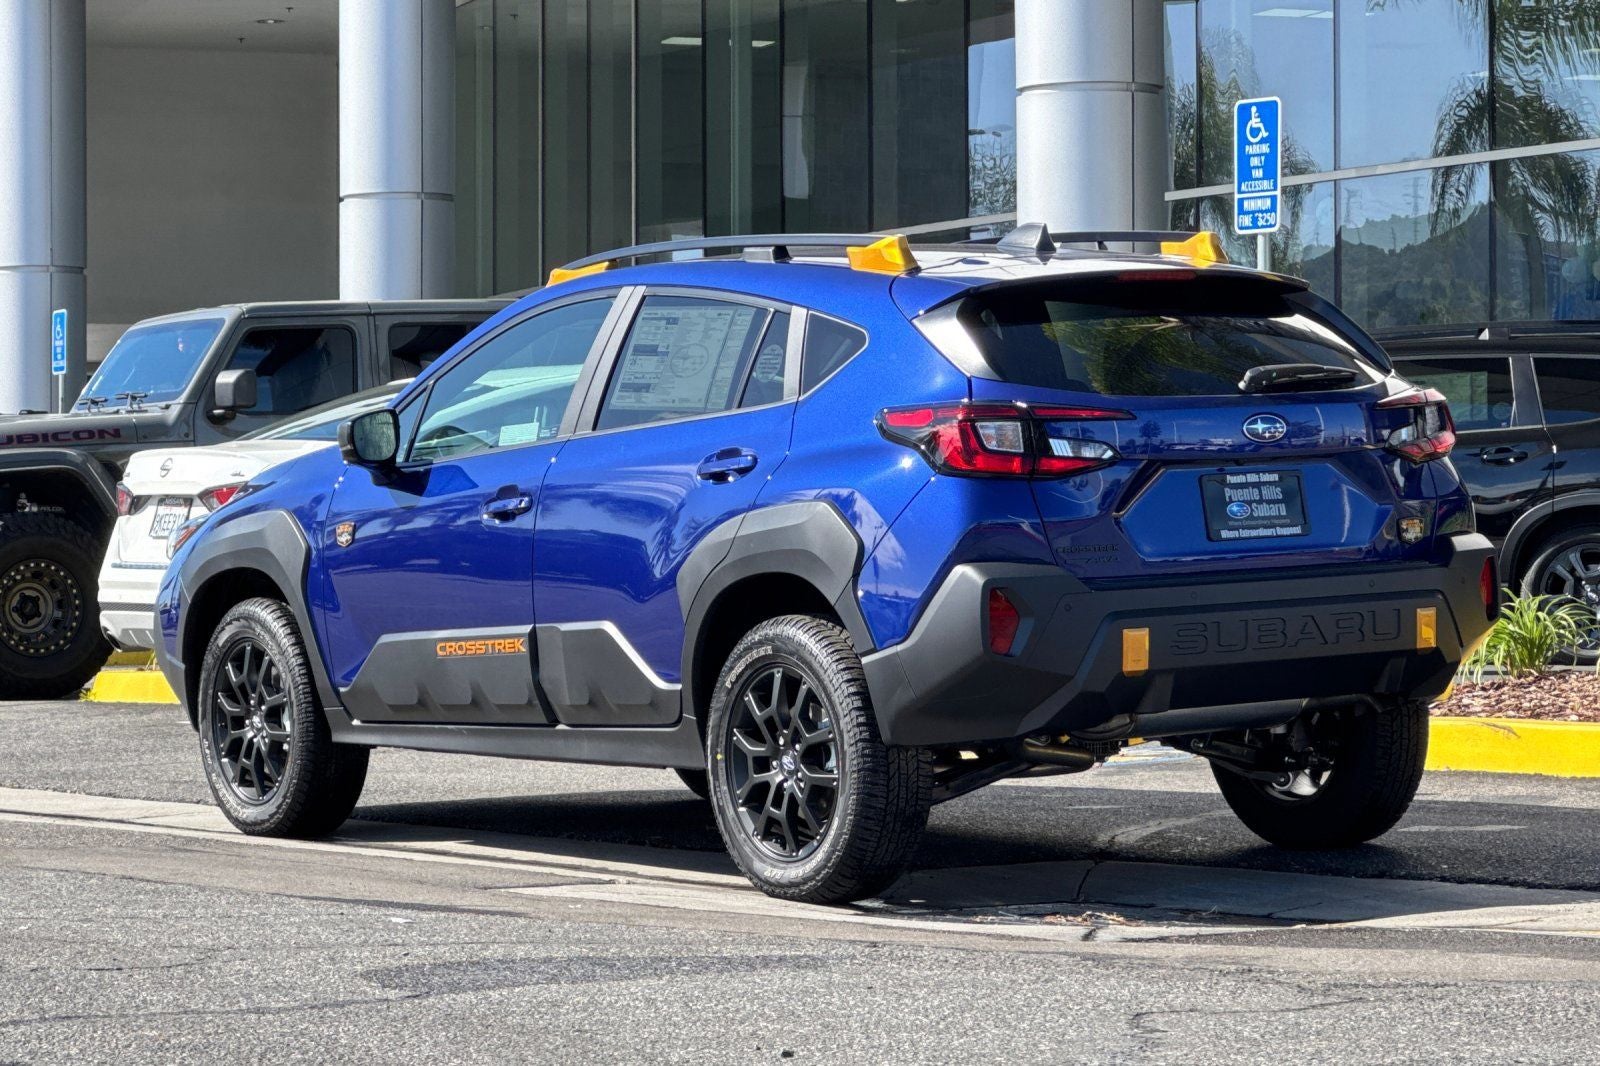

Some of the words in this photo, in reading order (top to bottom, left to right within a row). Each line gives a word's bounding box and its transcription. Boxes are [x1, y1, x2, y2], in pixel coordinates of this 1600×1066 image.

[1245, 143, 1270, 155] PARKING
[1249, 156, 1265, 167] ONLY
[1251, 168, 1264, 179] VAN
[1240, 179, 1275, 192] ACCESSIBLE
[1243, 198, 1272, 212] MINIMUM
[1238, 214, 1253, 227] FINE
[1226, 474, 1246, 484] Puente
[1246, 473, 1260, 483] Hills
[1260, 473, 1279, 482] Subaru
[1224, 486, 1260, 502] Puente
[1260, 484, 1283, 500] Hills
[1251, 502, 1287, 517] Subaru
[1170, 608, 1401, 656] SUBARU
[436, 637, 527, 656] CROSSTREK
